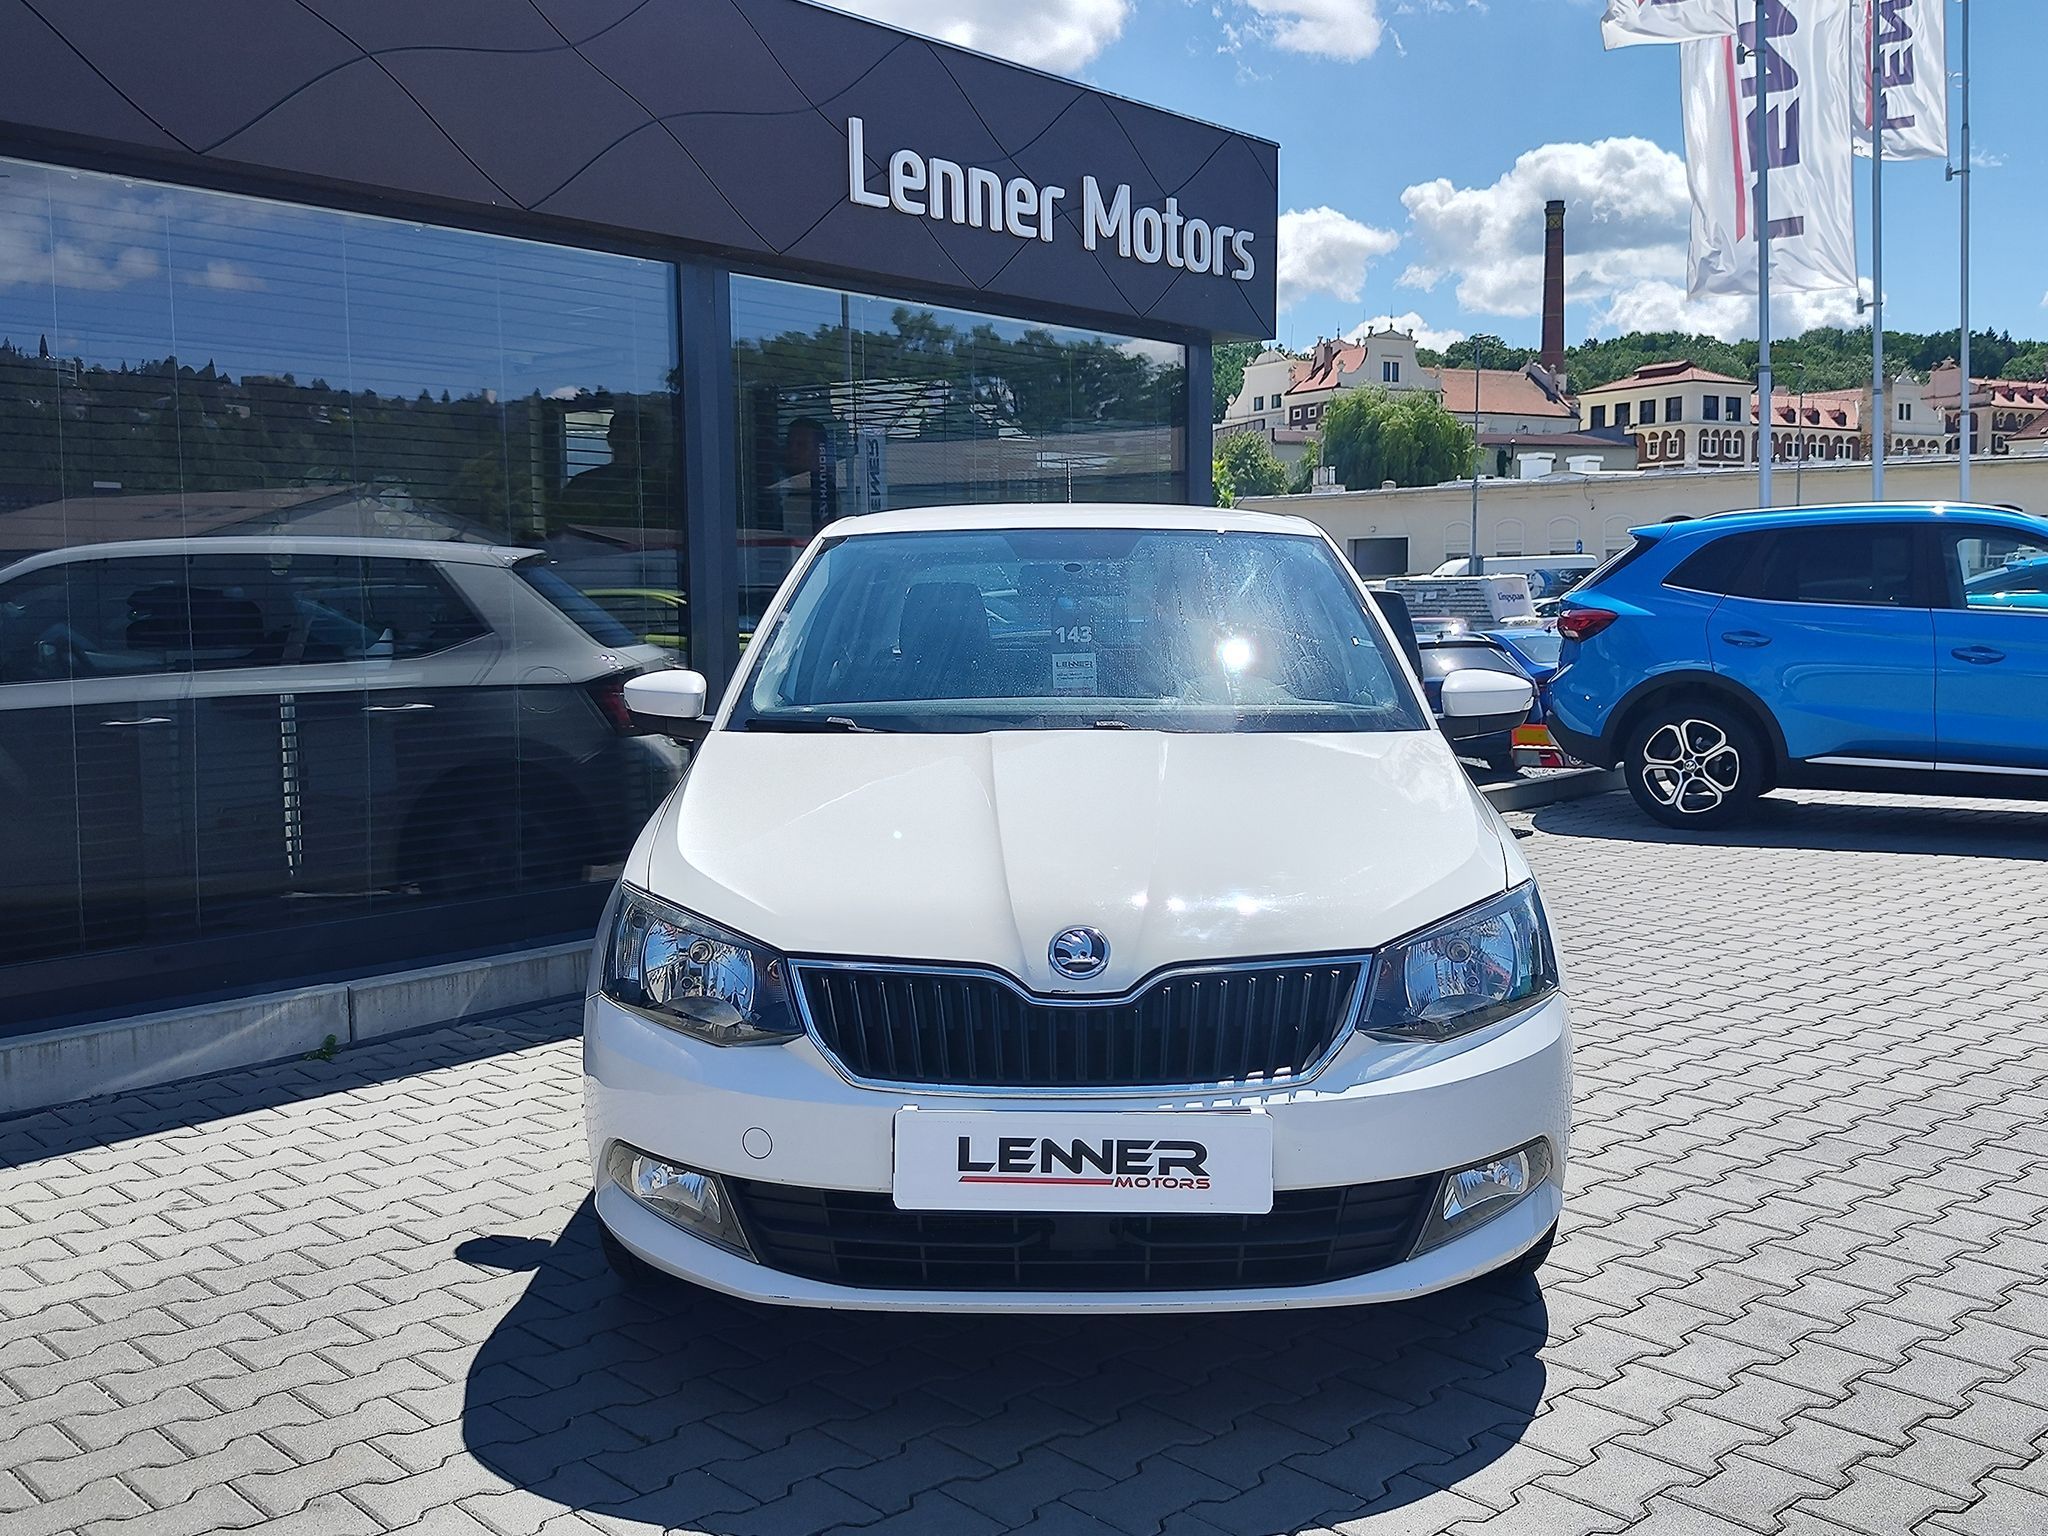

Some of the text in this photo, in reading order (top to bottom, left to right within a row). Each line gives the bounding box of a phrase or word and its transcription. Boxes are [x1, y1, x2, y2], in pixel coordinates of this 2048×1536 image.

[847, 116, 1257, 281] Lenner Motors
[1055, 625, 1093, 643] 143
[957, 1136, 1211, 1177] LENNER
[1114, 1176, 1211, 1190] MOTORS
